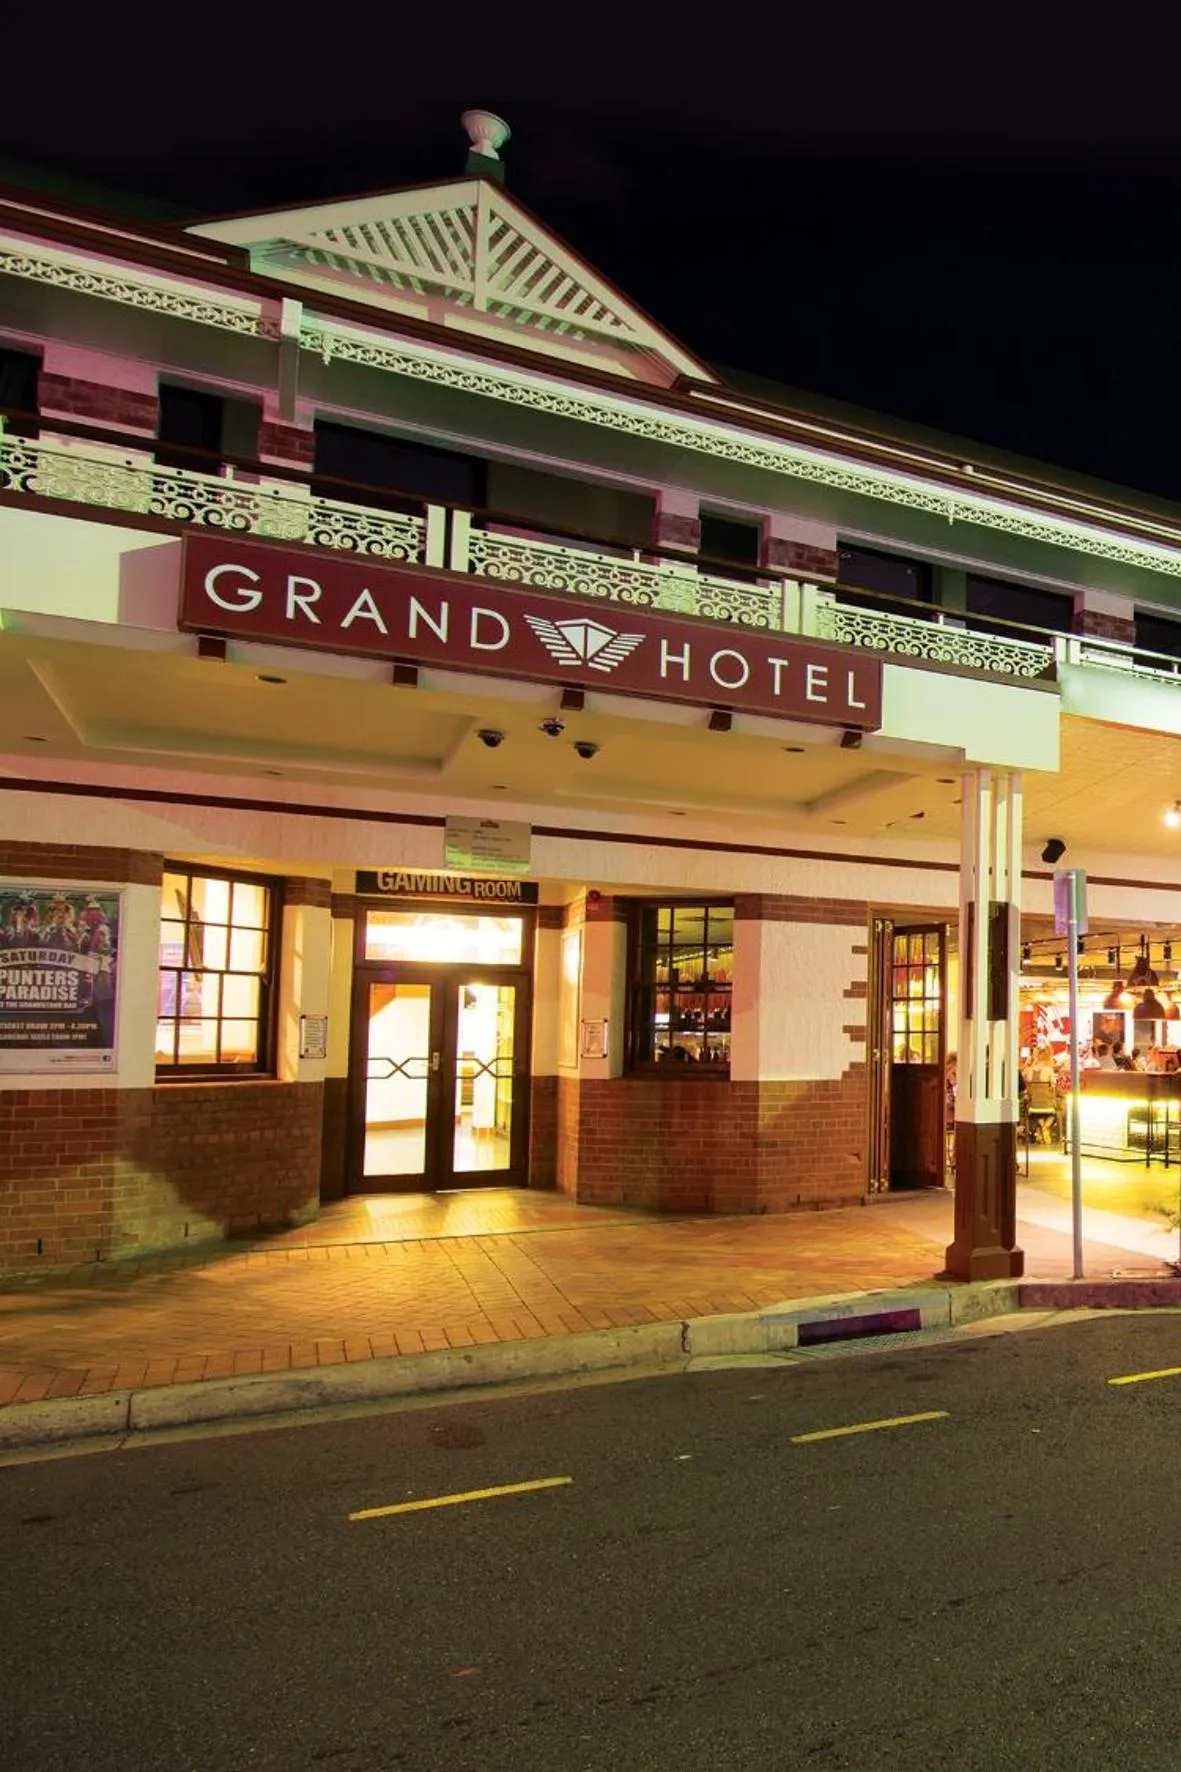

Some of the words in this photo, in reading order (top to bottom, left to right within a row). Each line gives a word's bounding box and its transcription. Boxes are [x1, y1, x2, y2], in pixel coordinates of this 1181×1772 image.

[203, 563, 511, 651] GRAND
[660, 639, 866, 709] HOTEL
[376, 871, 472, 894] GAMING
[474, 881, 522, 897] ROOM
[0, 950, 76, 965] SATURDAY
[0, 969, 80, 986] PUNTERS
[0, 985, 79, 1001] PARADISE
